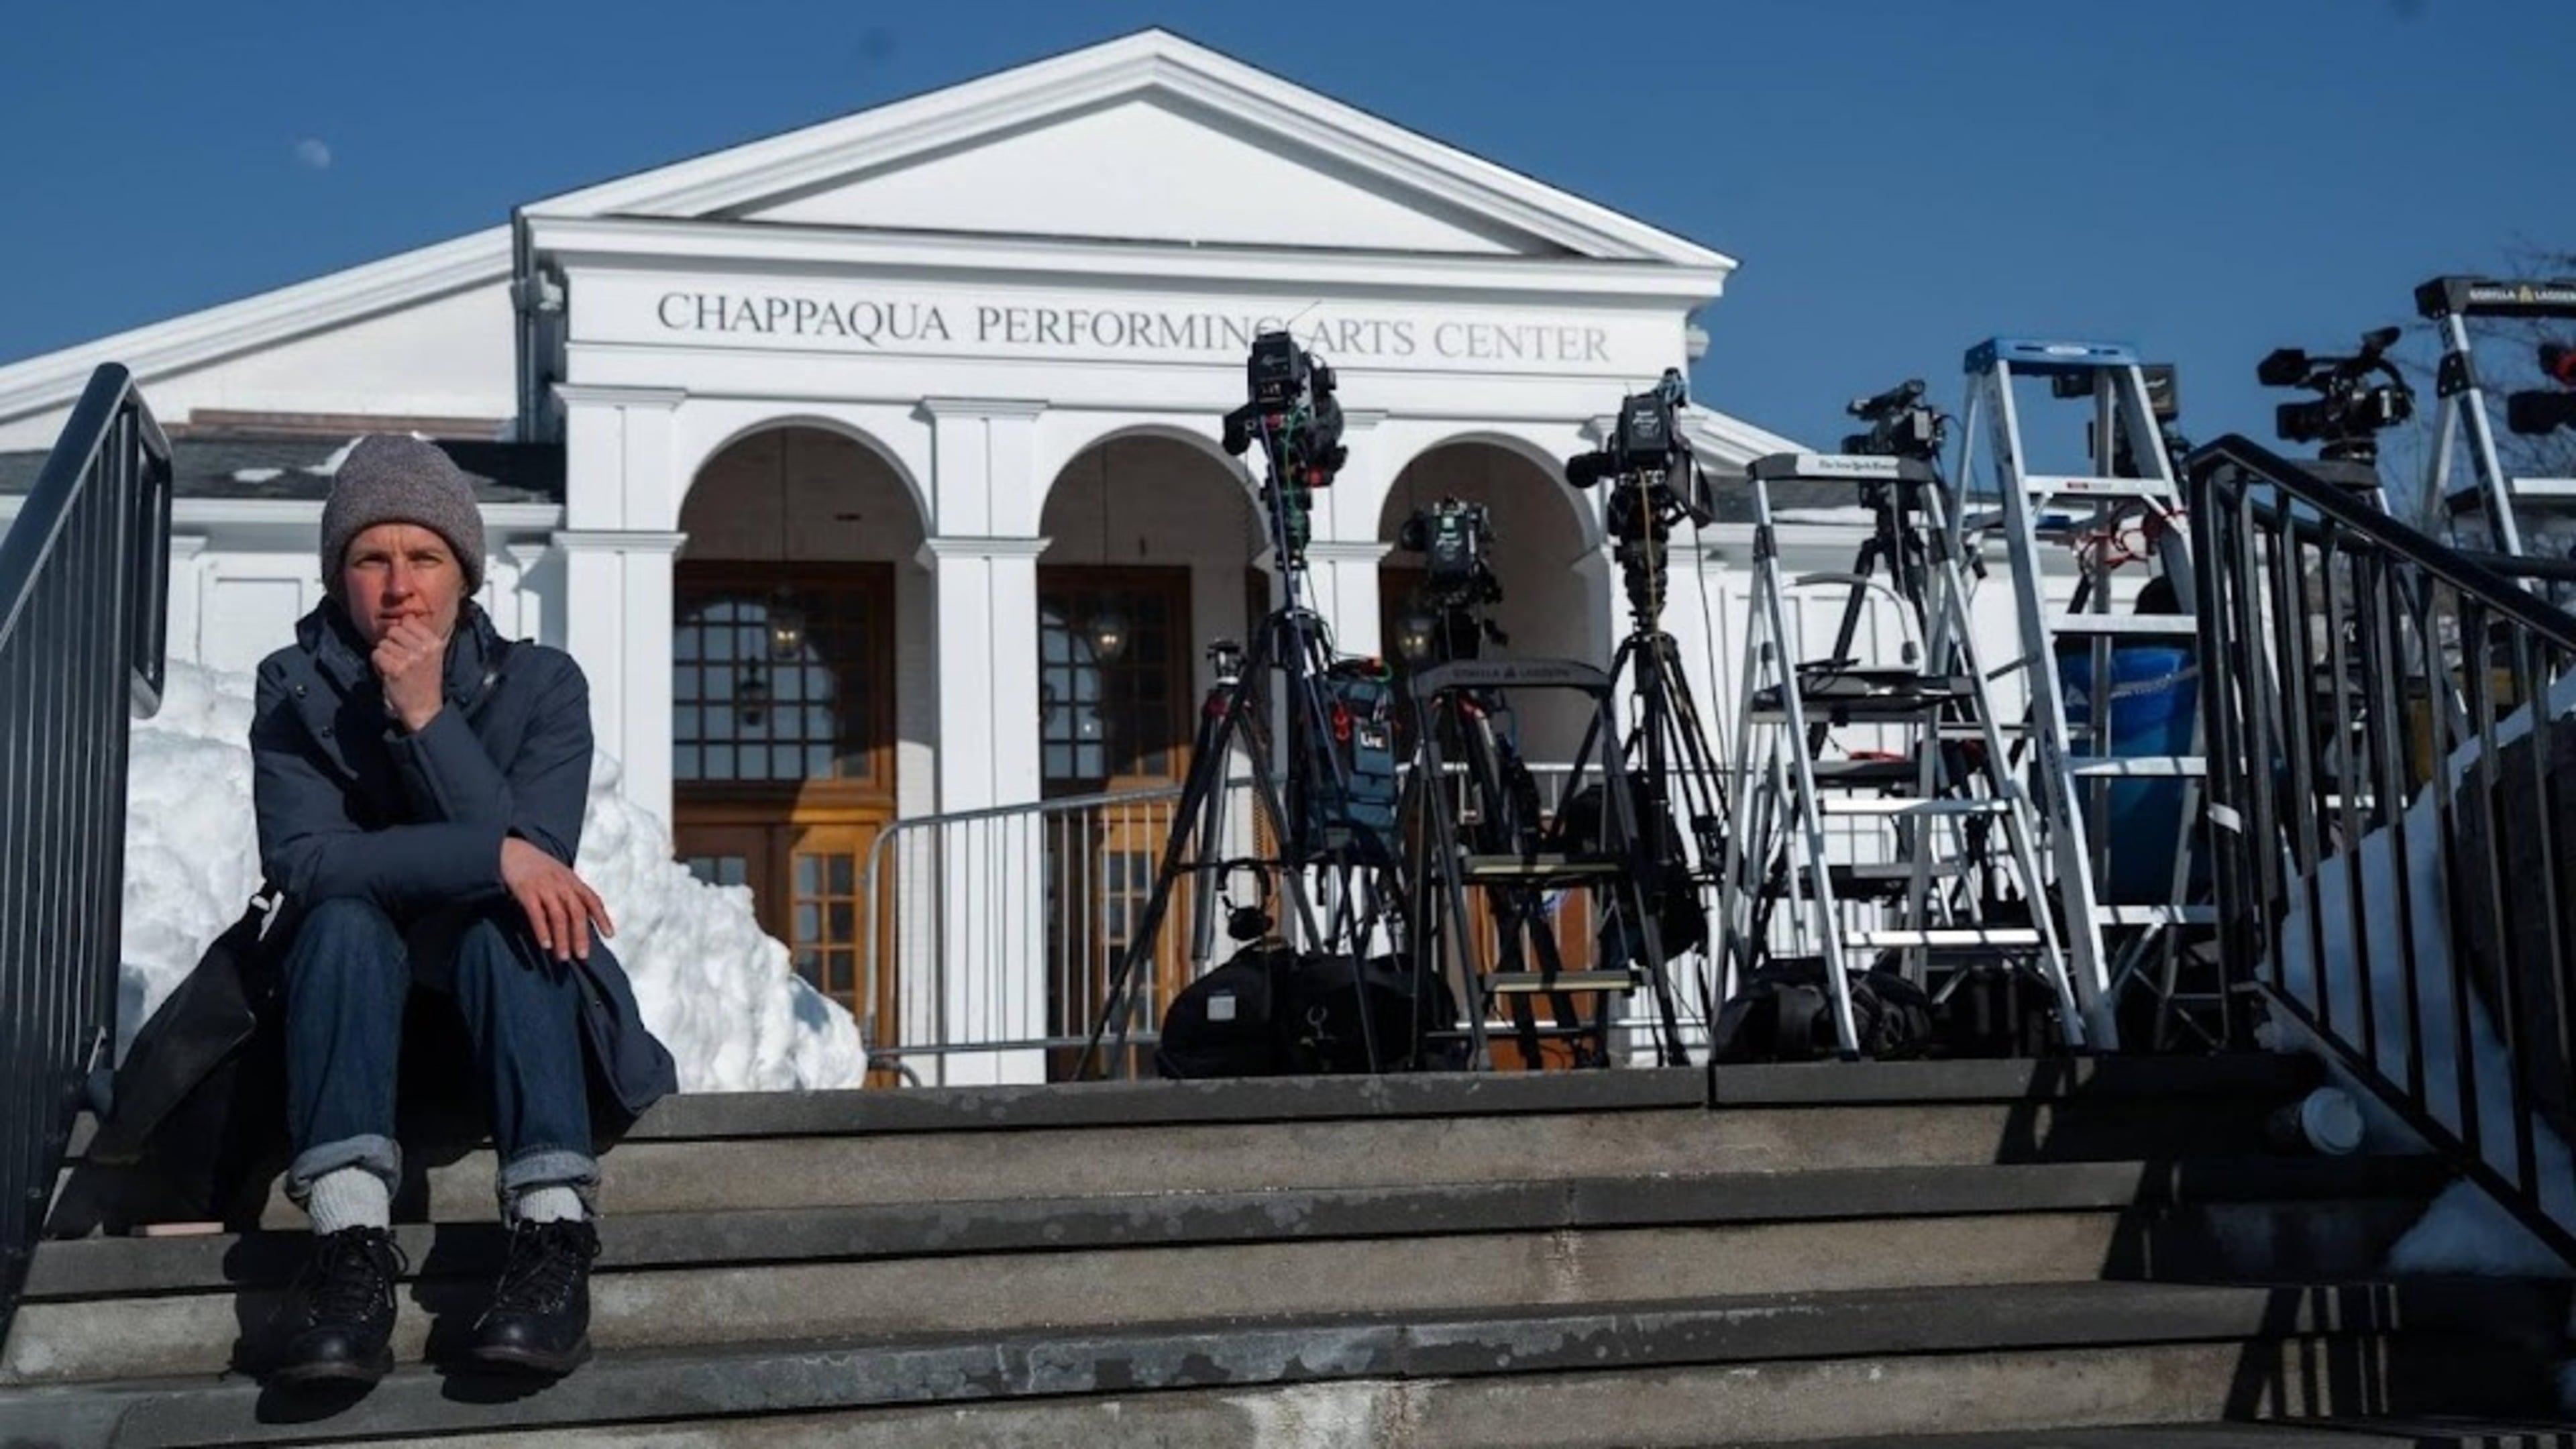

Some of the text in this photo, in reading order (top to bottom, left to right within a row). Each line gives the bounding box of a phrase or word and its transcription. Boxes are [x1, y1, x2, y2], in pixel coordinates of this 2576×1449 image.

[657, 291, 951, 347] CHAPPAQUA
[1309, 319, 1415, 356] ARTS
[1434, 321, 1610, 362] CENTER
